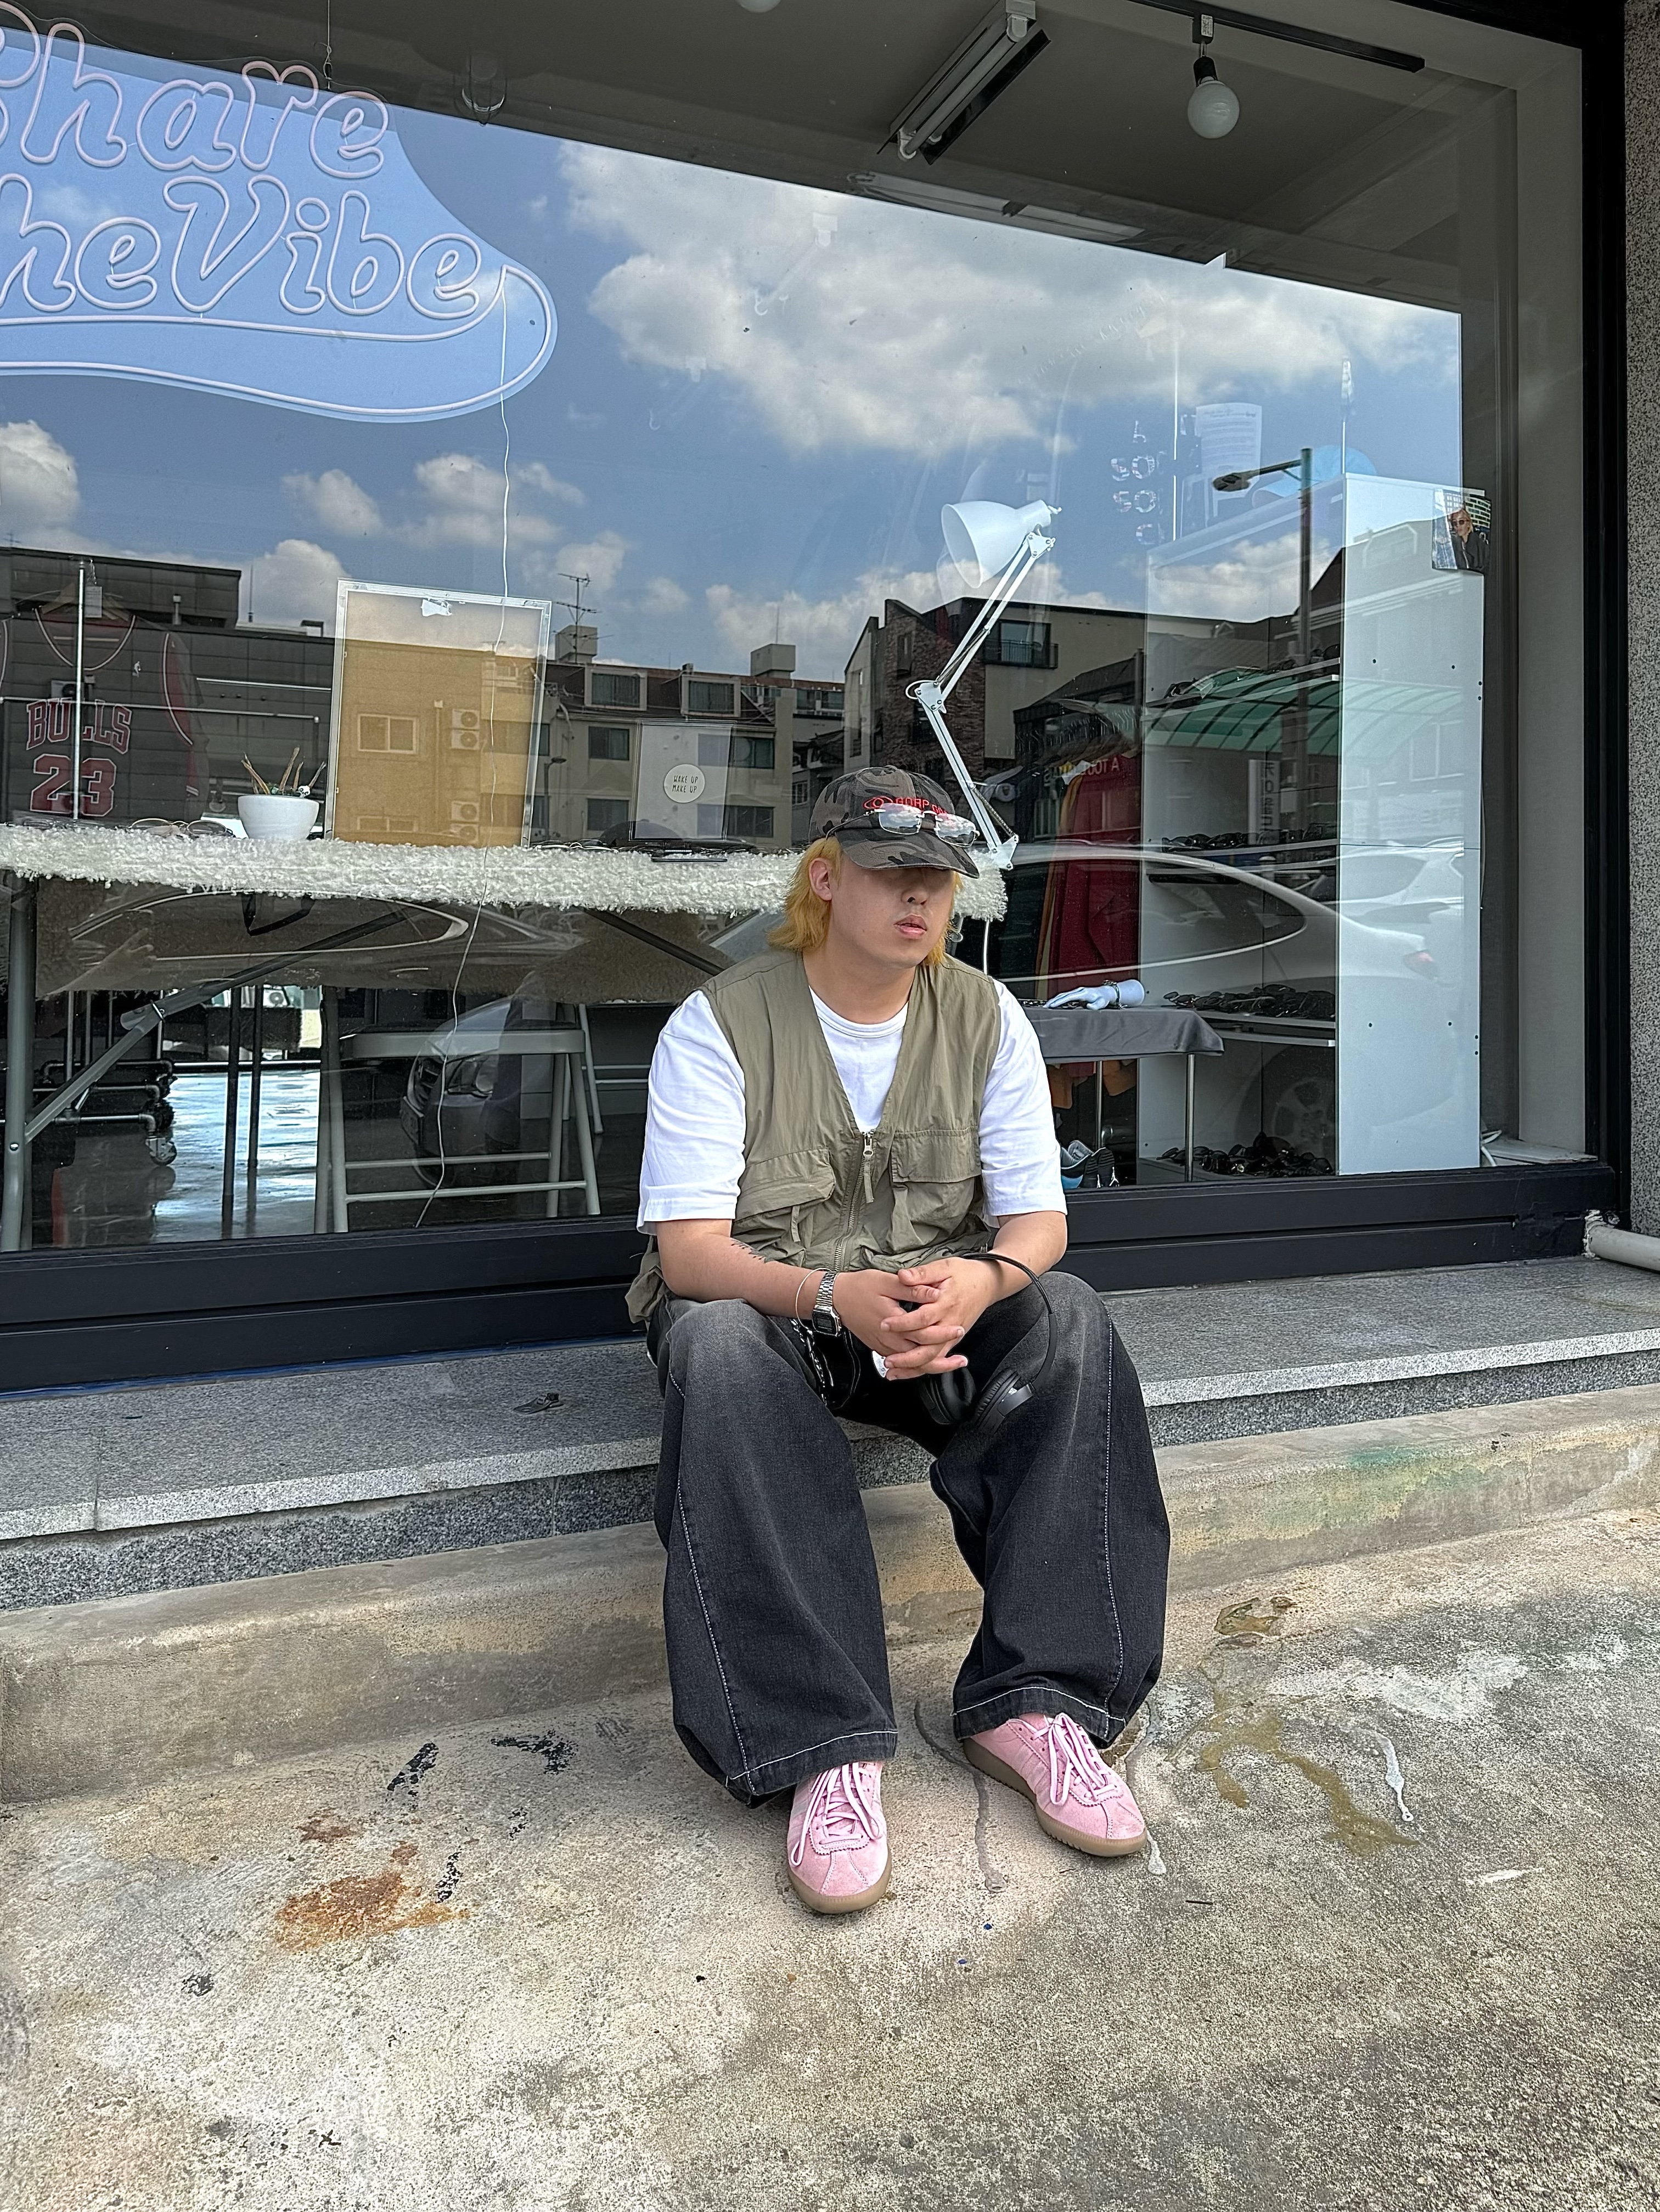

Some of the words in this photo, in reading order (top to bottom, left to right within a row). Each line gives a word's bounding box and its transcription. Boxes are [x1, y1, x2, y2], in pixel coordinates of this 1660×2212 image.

[673, 775, 688, 783] WAKE
[30, 753, 117, 817] 23
[672, 784, 686, 793] MAKE
[689, 785, 697, 793] UP
